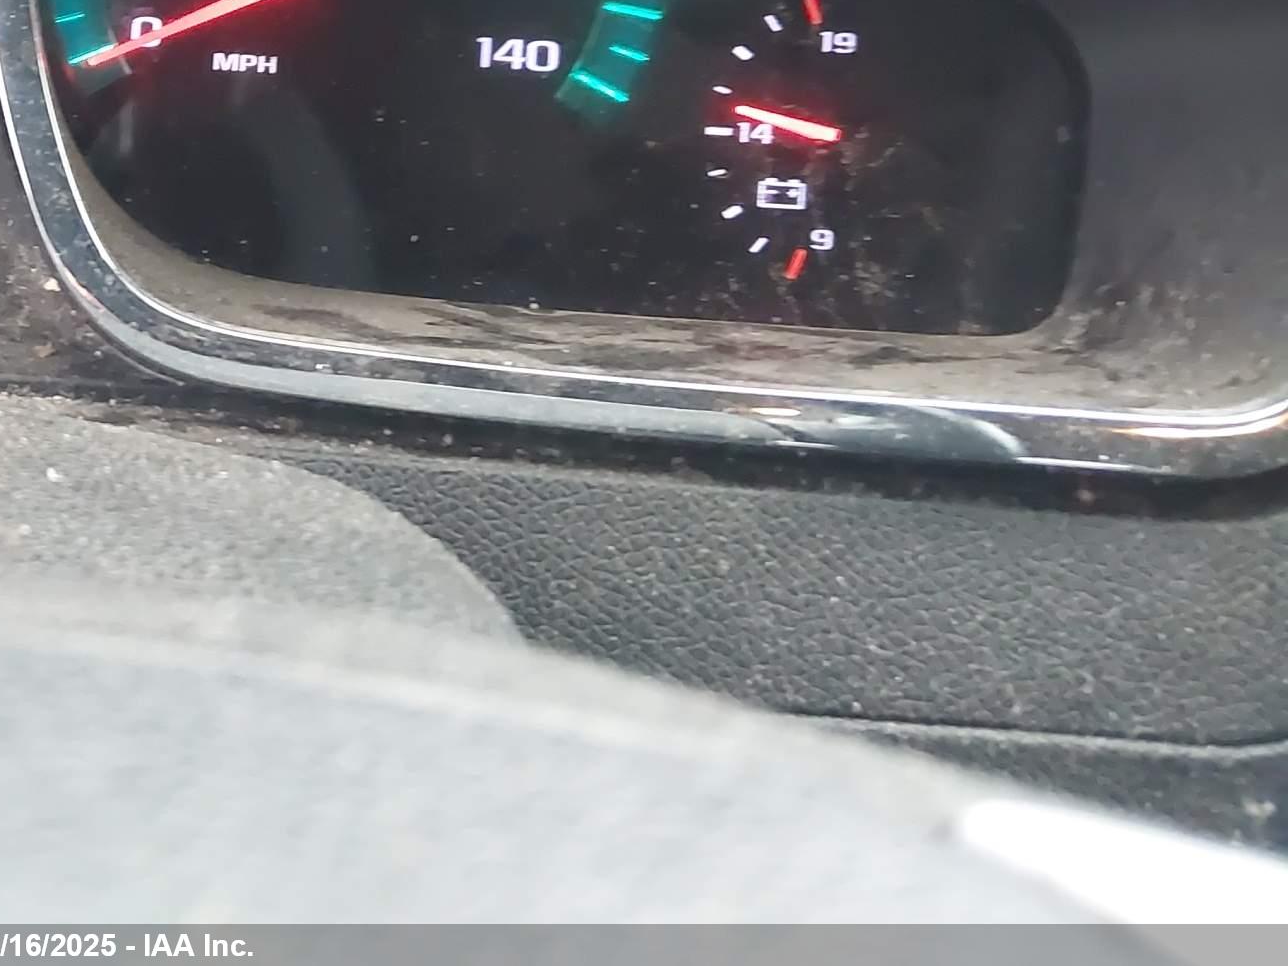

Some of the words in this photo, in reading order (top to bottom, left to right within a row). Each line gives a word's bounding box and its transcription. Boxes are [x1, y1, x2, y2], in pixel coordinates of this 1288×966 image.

[131, 16, 163, 47] 0
[819, 31, 858, 54] 19
[212, 52, 278, 74] MPH
[476, 37, 560, 73] 140
[736, 122, 775, 144] 14
[810, 229, 834, 250] 9
